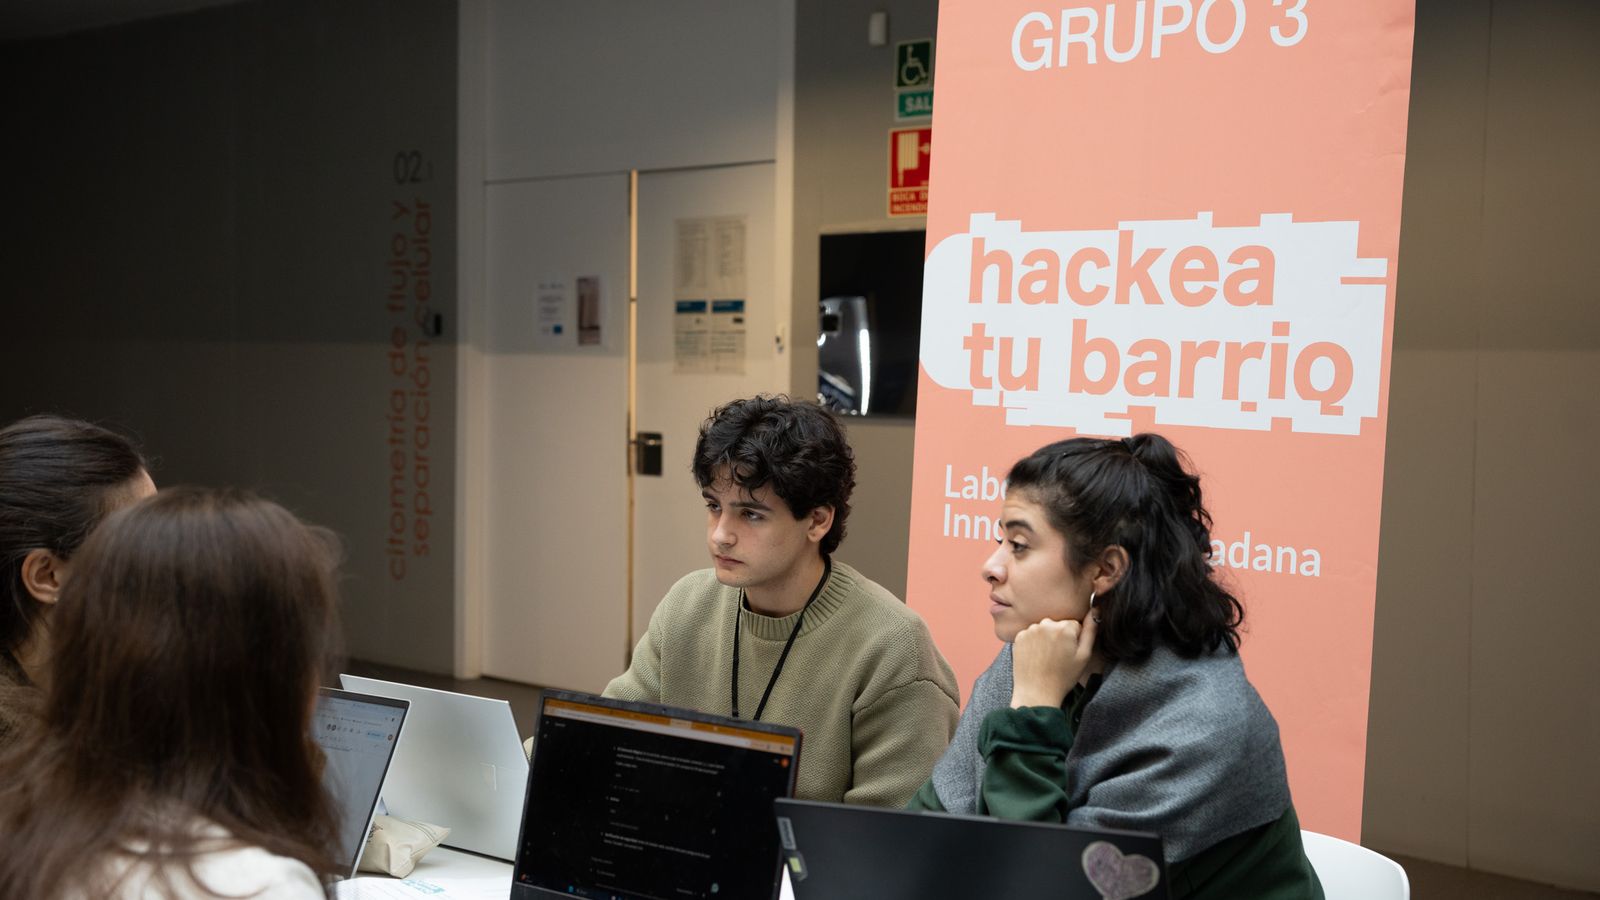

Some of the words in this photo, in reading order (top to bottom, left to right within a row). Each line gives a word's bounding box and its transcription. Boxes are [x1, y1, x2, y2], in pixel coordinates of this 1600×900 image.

[1011, 0, 1247, 71] GRUPO
[1270, 0, 1308, 47] 3
[391, 200, 411, 222] y
[386, 232, 412, 315] flujo
[970, 230, 1275, 307] hackea
[386, 326, 407, 377] de
[963, 321, 1042, 393] tu
